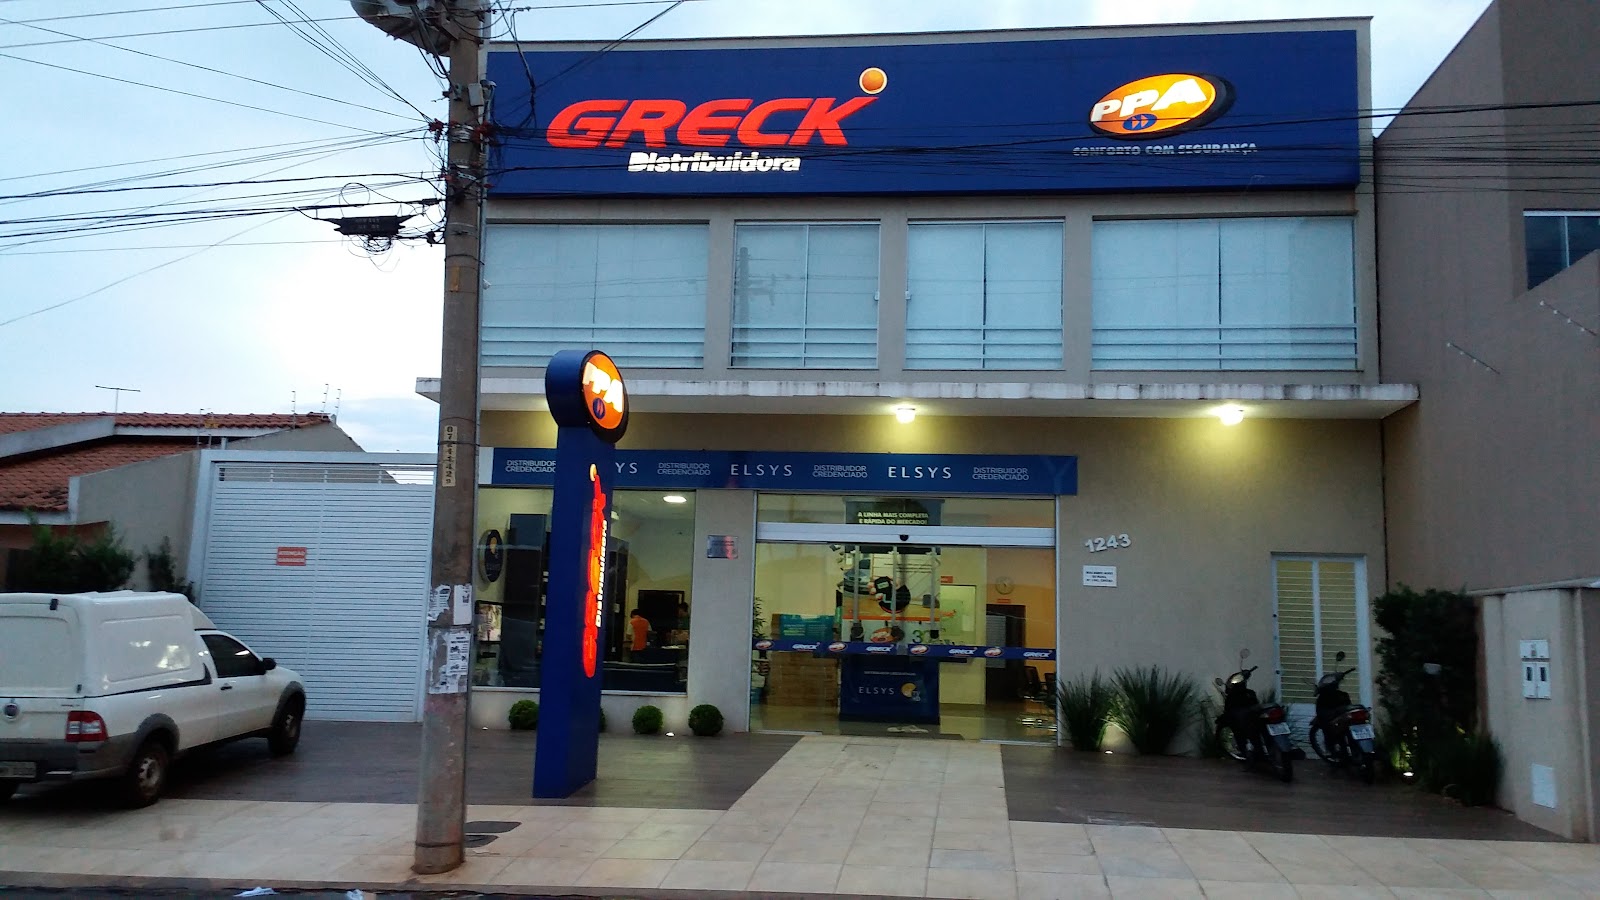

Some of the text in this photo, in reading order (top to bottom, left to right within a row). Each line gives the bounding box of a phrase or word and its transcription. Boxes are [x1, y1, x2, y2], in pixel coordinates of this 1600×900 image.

[1090, 78, 1207, 122] PPA
[546, 96, 879, 149] GRECK
[1144, 144, 1175, 155] COM
[627, 151, 802, 173] Distribuidora
[582, 361, 624, 413] PPA
[657, 468, 712, 476] CREDENCIADO
[658, 462, 711, 470] DISTRIBUIDOR
[730, 463, 793, 477] ELSYS
[973, 467, 1029, 475] DISTRIBUIDOR
[812, 471, 868, 479] CREDENCIADO
[887, 466, 952, 479] ELSYS
[972, 473, 1030, 481] CREDENCIADO
[1085, 533, 1132, 553] 1243
[858, 686, 895, 695] ELSYS
